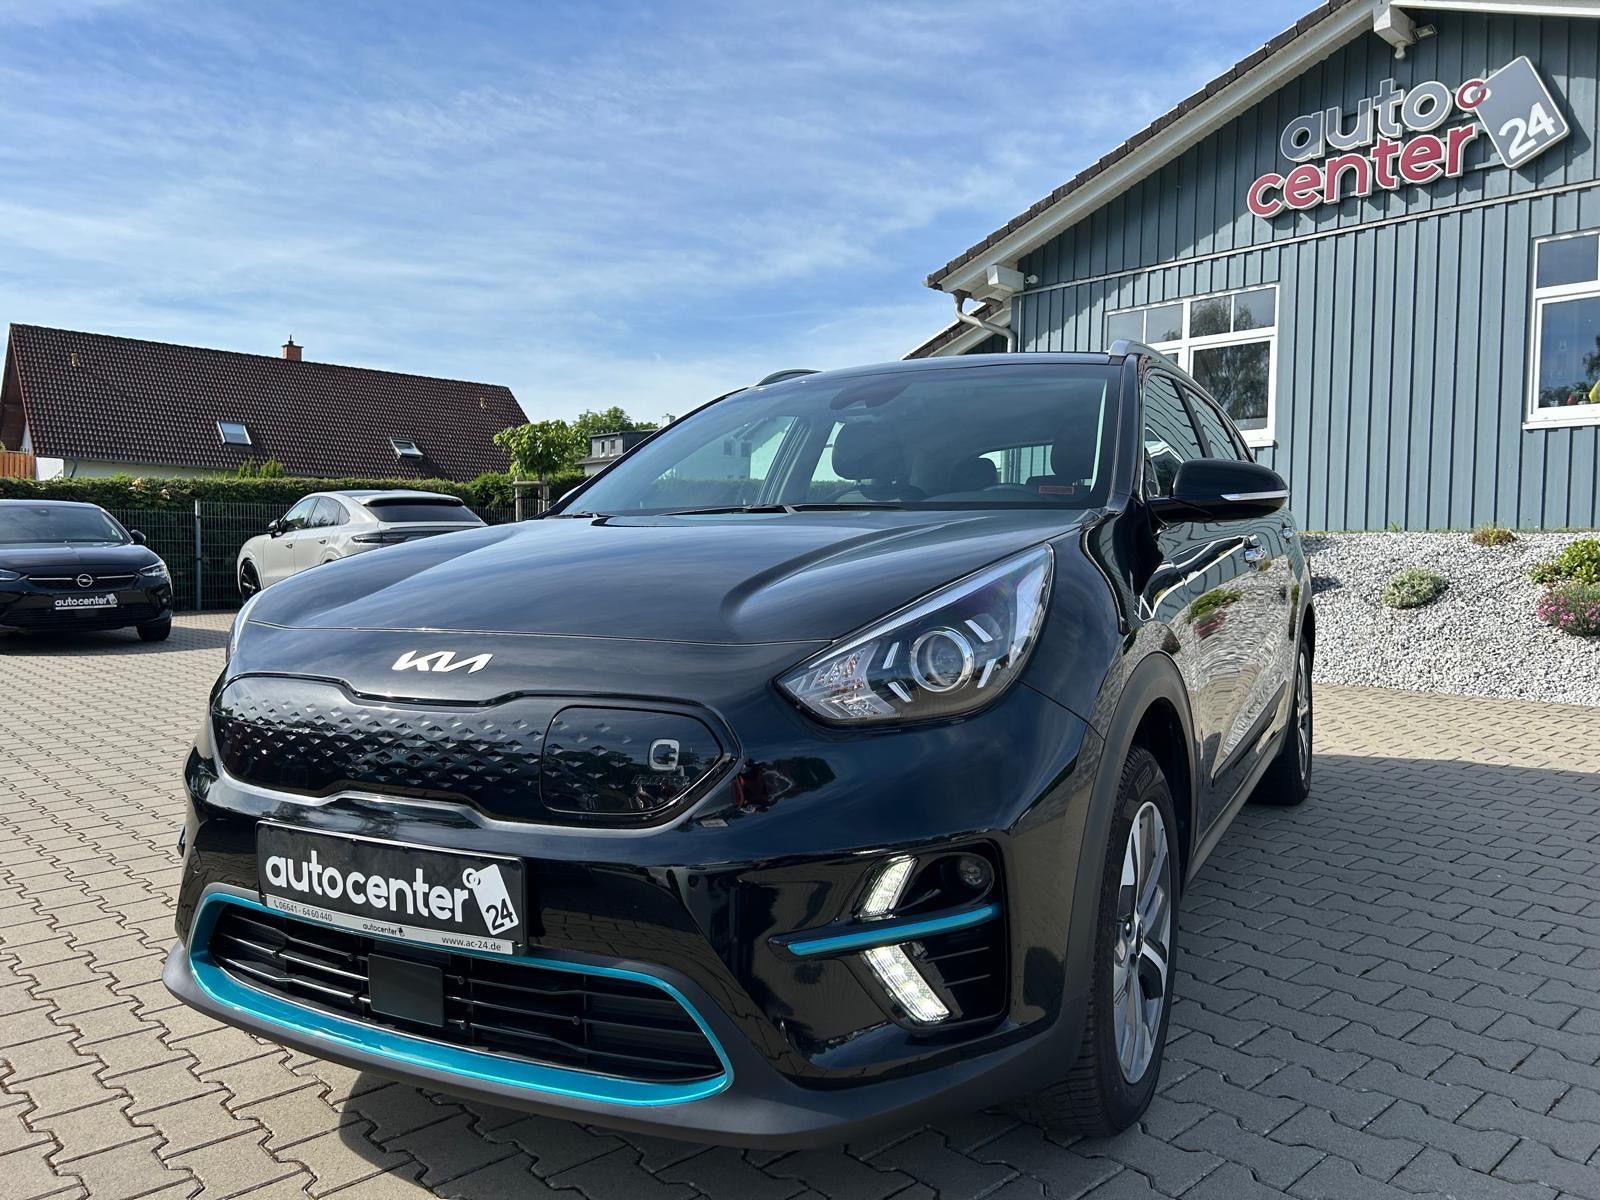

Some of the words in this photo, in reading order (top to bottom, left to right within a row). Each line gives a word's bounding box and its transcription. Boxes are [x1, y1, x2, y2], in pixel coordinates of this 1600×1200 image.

[1280, 78, 1453, 161] auto
[1498, 102, 1556, 160] 24
[1247, 122, 1479, 218] center
[485, 898, 514, 931] 24
[441, 937, 502, 951] www.ac-24.de
